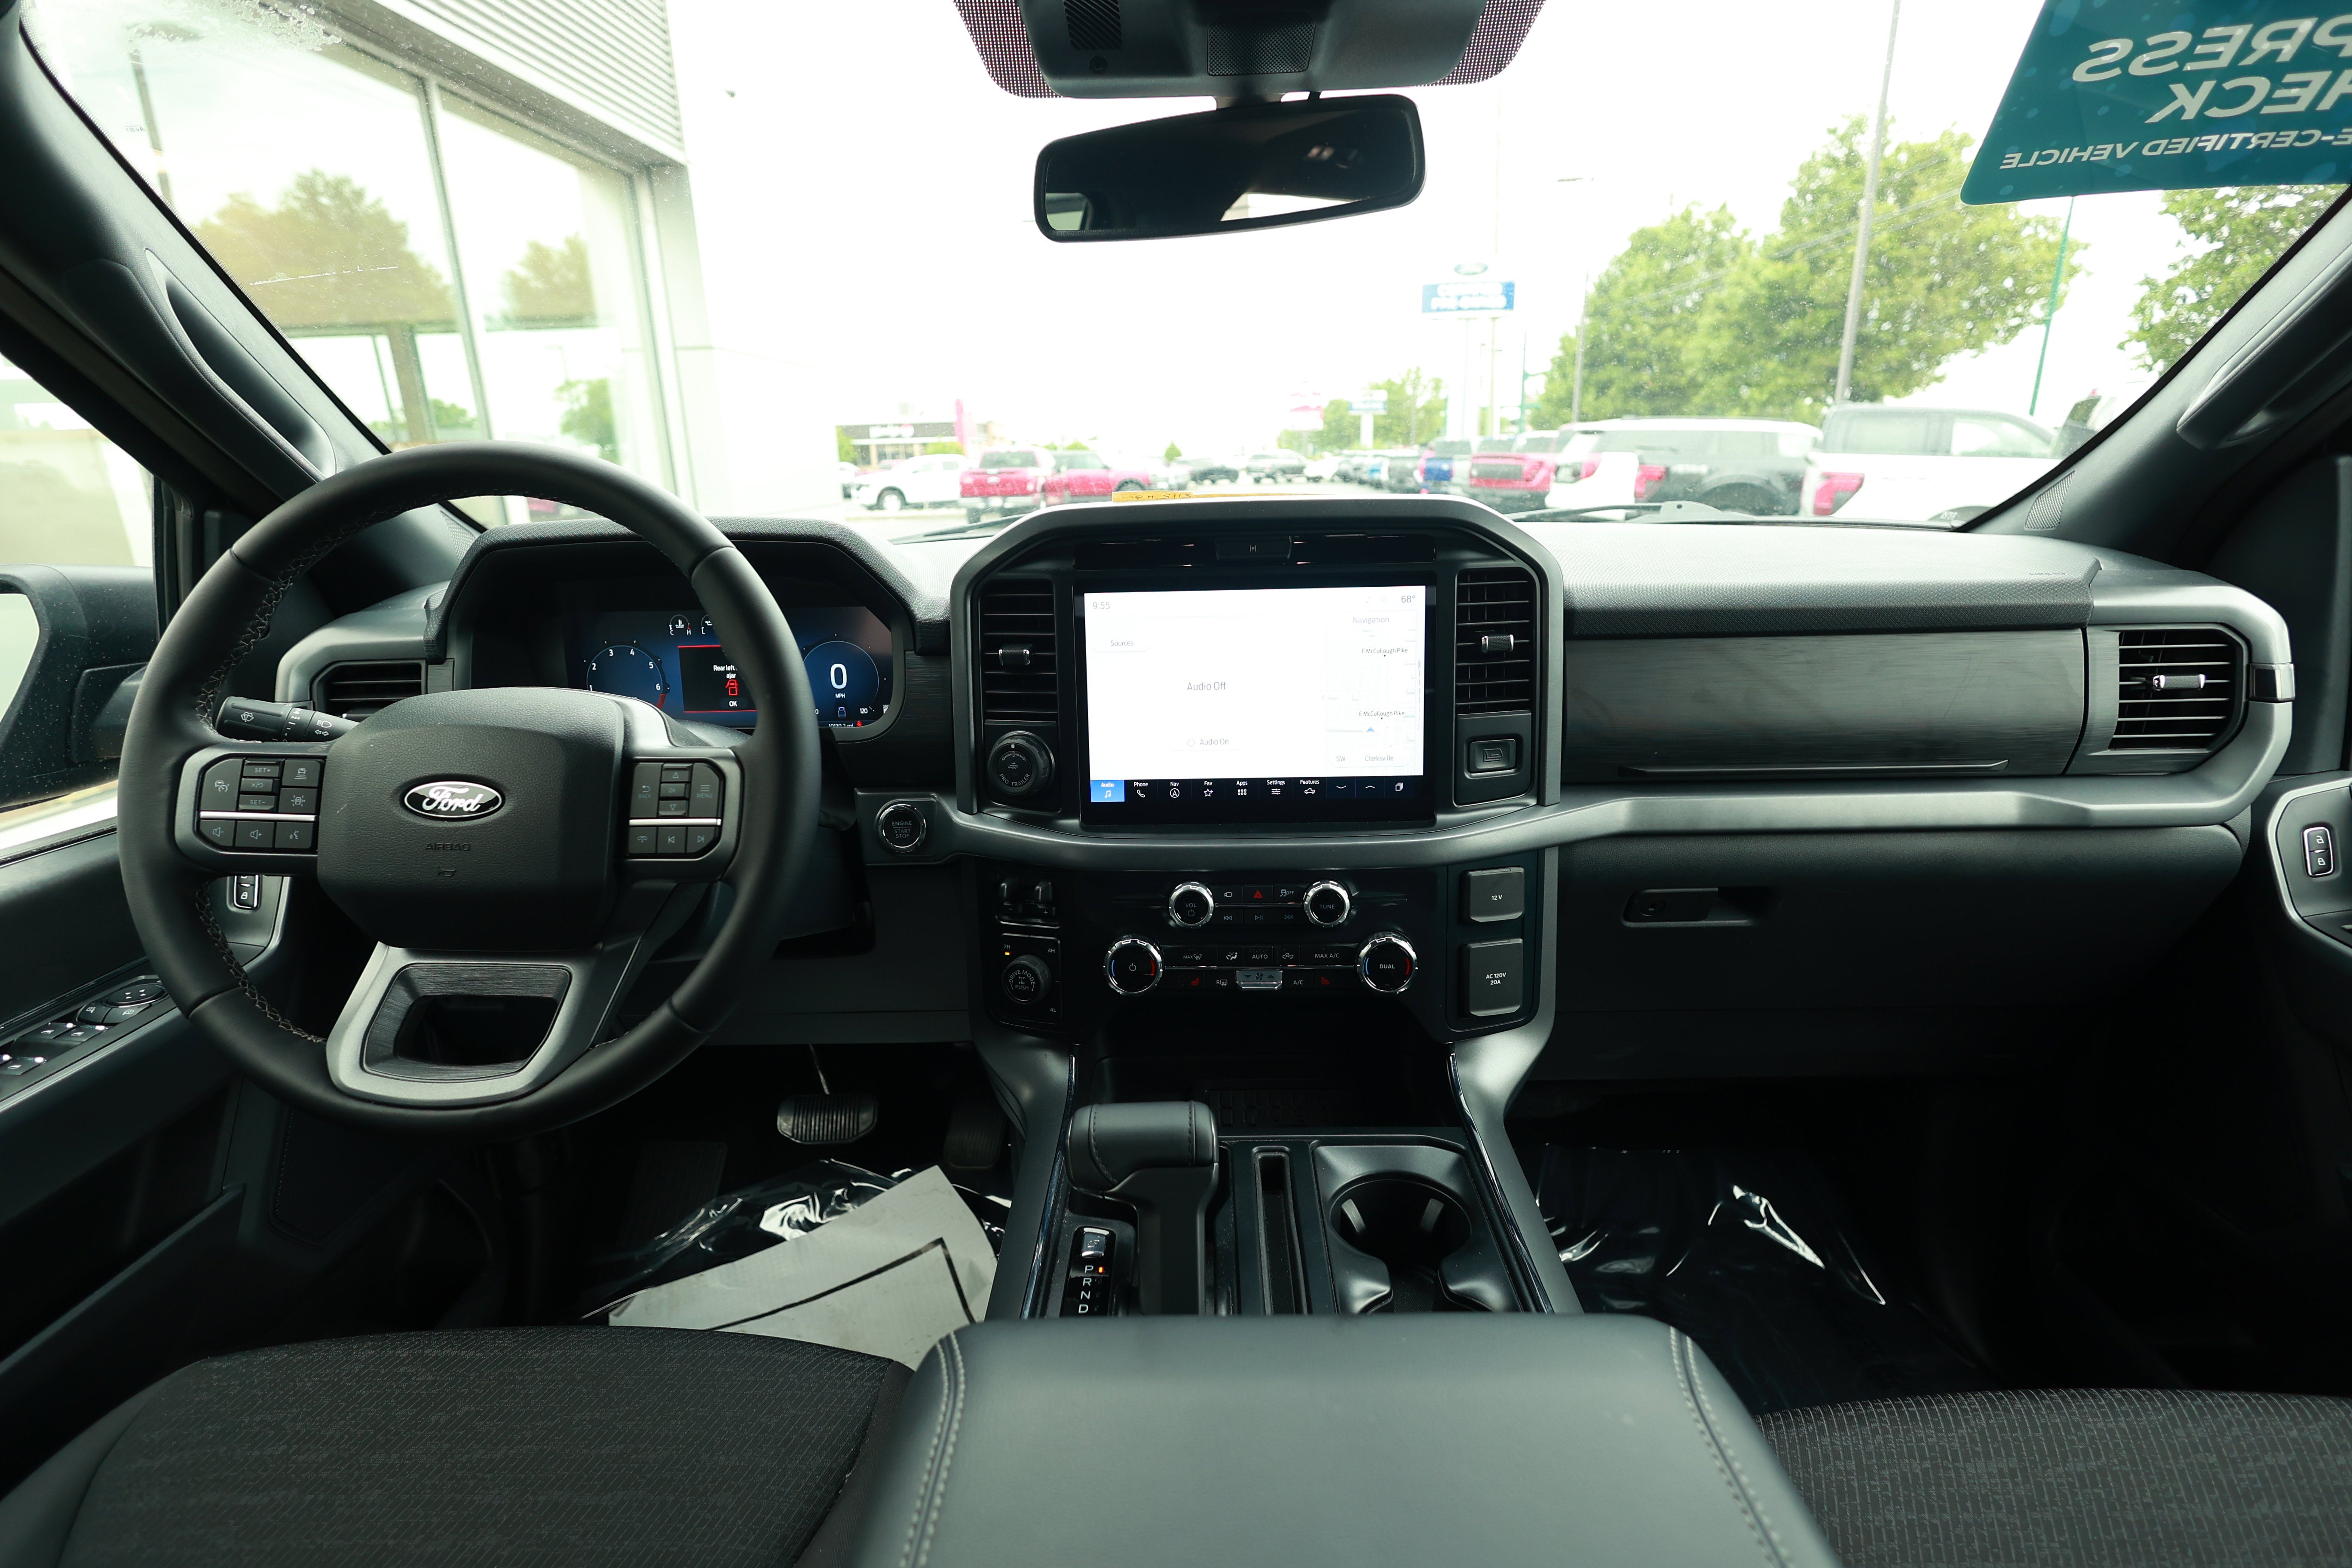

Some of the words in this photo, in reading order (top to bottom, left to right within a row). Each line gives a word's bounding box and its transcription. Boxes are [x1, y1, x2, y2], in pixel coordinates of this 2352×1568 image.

[1401, 595, 1416, 603] 68°
[1093, 601, 1110, 609] 9:55
[830, 663, 847, 689] 0
[1187, 682, 1212, 691] Audio
[1213, 681, 1227, 690] Off
[999, 773, 1009, 784] PRO
[1011, 773, 1030, 787] TRAILER
[422, 786, 484, 812] Ford
[425, 842, 471, 851] AIRBAG
[1009, 969, 1021, 983] DRIVE
[1022, 970, 1036, 985] MODE
[1084, 1265, 1094, 1274] P
[1082, 1278, 1092, 1286] R
[1080, 1290, 1090, 1300] N
[1078, 1304, 1089, 1314] D
